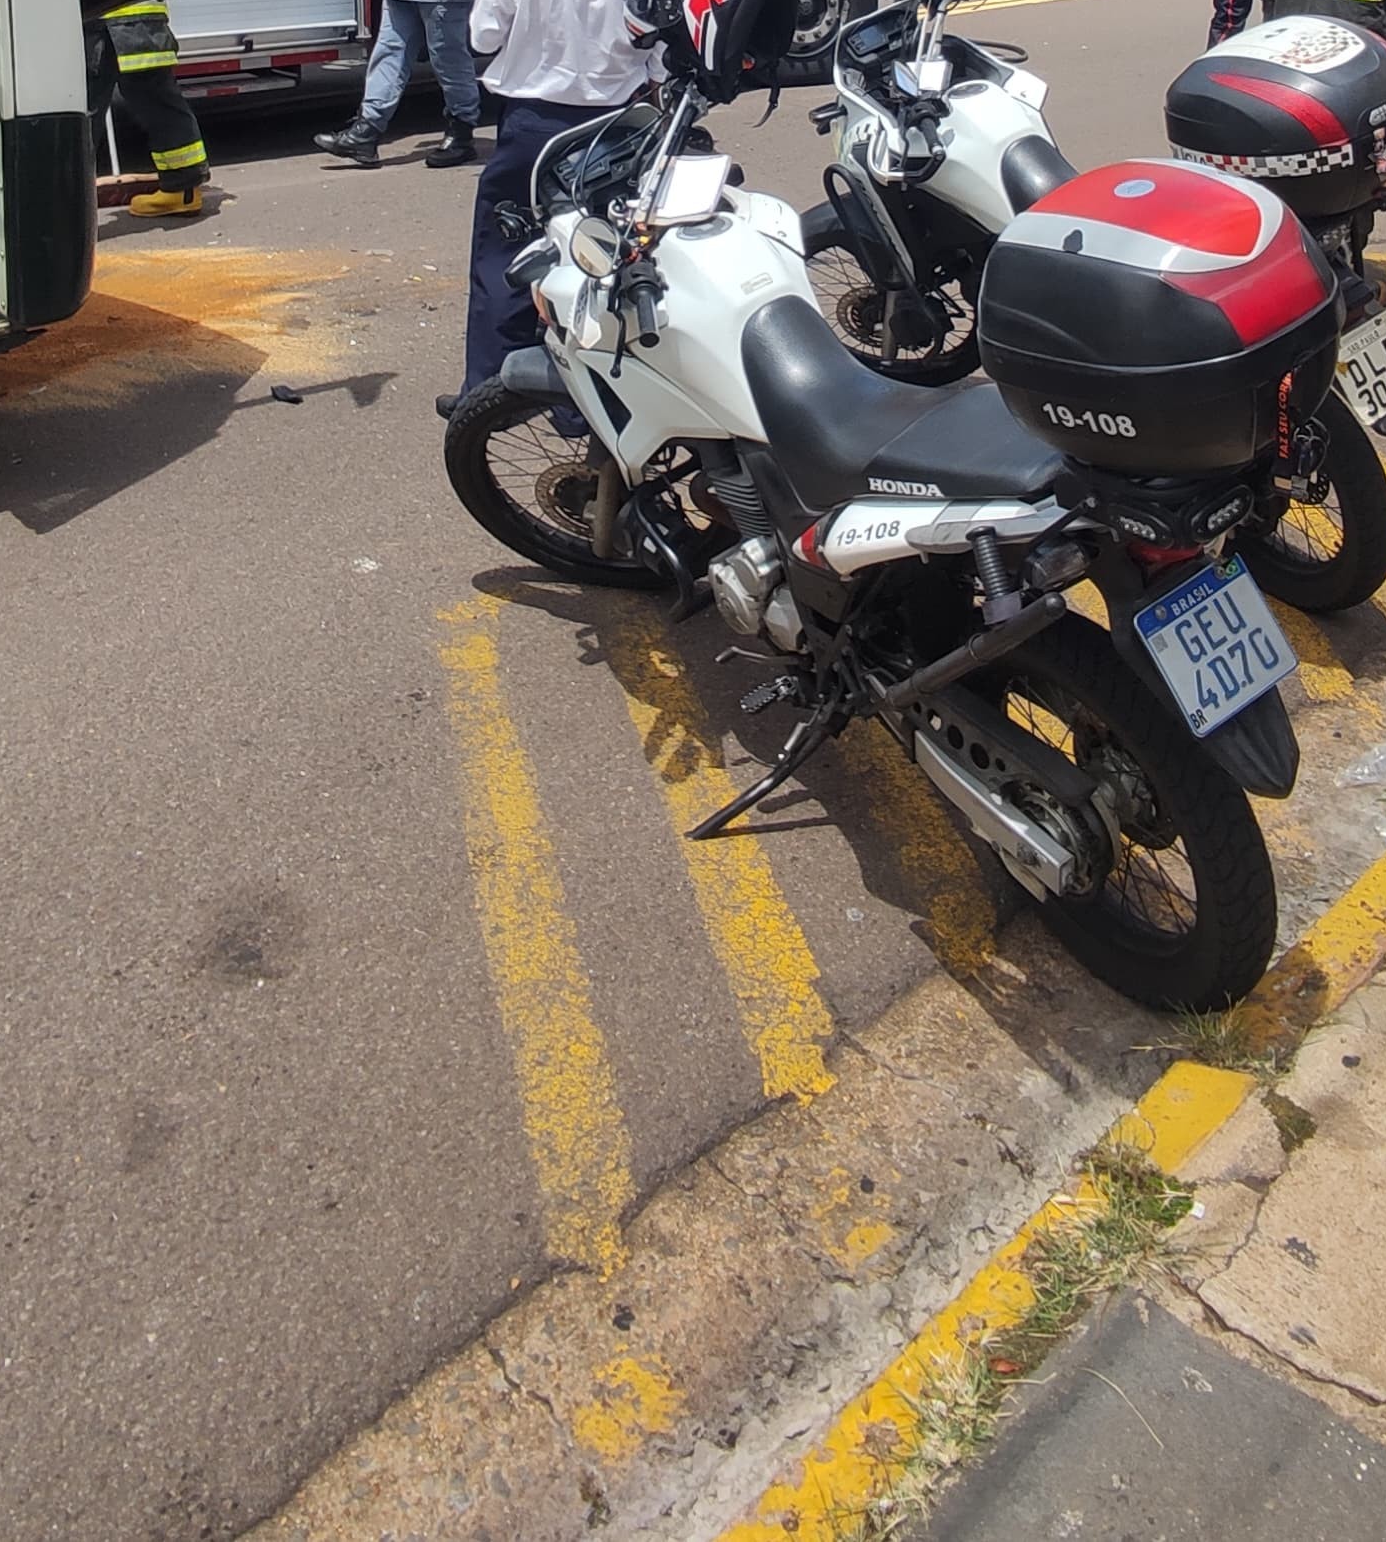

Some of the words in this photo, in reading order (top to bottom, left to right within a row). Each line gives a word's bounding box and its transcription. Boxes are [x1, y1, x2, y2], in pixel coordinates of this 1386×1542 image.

[1043, 403, 1136, 437] 19-108
[1278, 411, 1289, 434] SEU
[1278, 436, 1289, 458] FAZ
[867, 477, 945, 497] HONDA
[837, 520, 901, 546] 19-108
[1171, 583, 1213, 616] BRASIL
[1174, 590, 1247, 663] GEU
[1196, 627, 1279, 709] 4D70
[1189, 709, 1208, 730] BR
